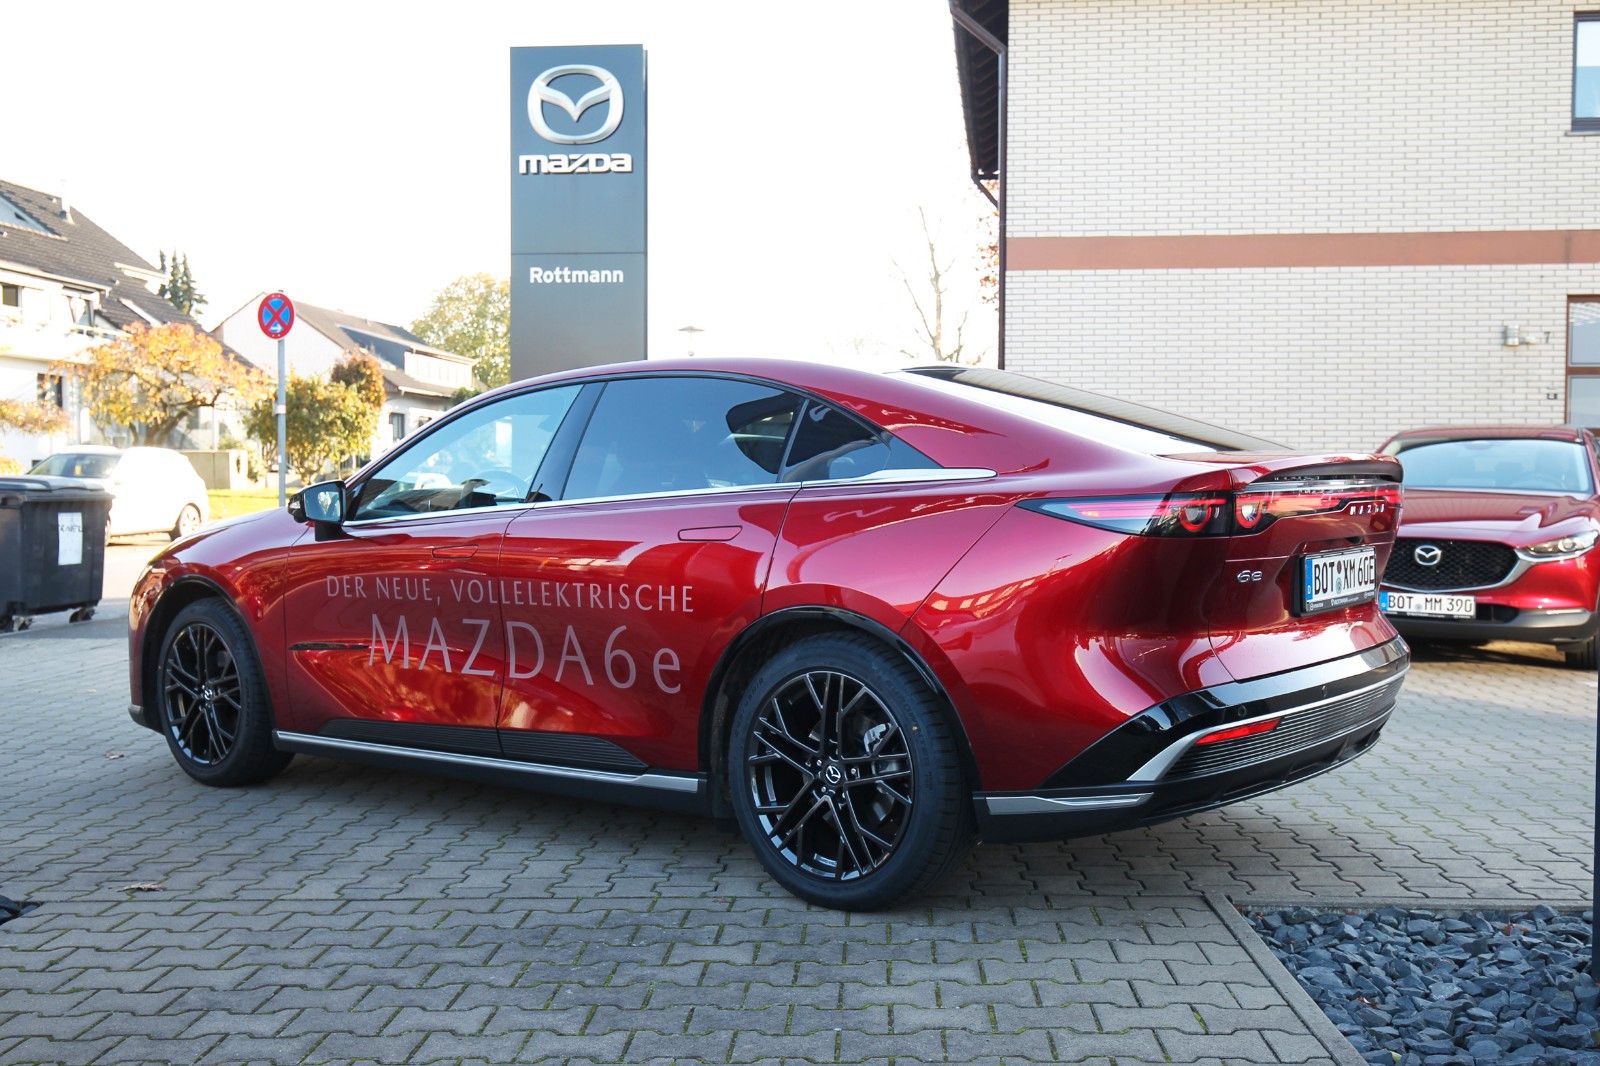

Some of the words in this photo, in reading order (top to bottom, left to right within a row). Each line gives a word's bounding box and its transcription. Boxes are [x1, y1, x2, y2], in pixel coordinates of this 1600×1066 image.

[529, 267, 624, 283] Rottmann
[326, 575, 367, 599] DER
[376, 577, 441, 606] NEUE,
[449, 578, 695, 612] VOLLELEKTRISCHE
[1314, 561, 1335, 595] BOT
[1343, 558, 1356, 590] XM
[1388, 595, 1414, 609] BOT
[1424, 597, 1442, 611] MM
[1446, 598, 1472, 613] 390
[368, 613, 682, 694] MAZDA6e
